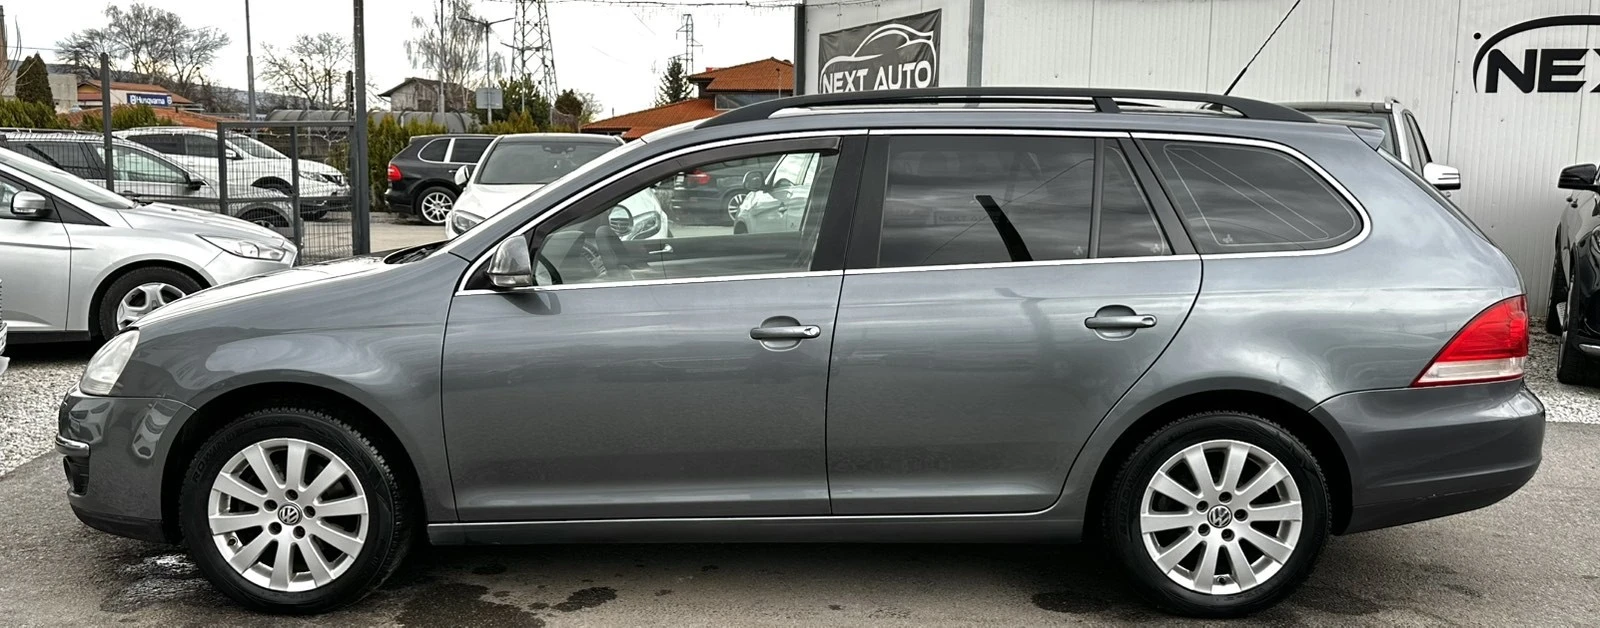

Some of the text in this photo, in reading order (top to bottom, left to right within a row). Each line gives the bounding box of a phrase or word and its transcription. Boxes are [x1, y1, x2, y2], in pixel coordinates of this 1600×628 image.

[822, 60, 932, 94] NEXT AUTO
[1485, 48, 1600, 94] NE
